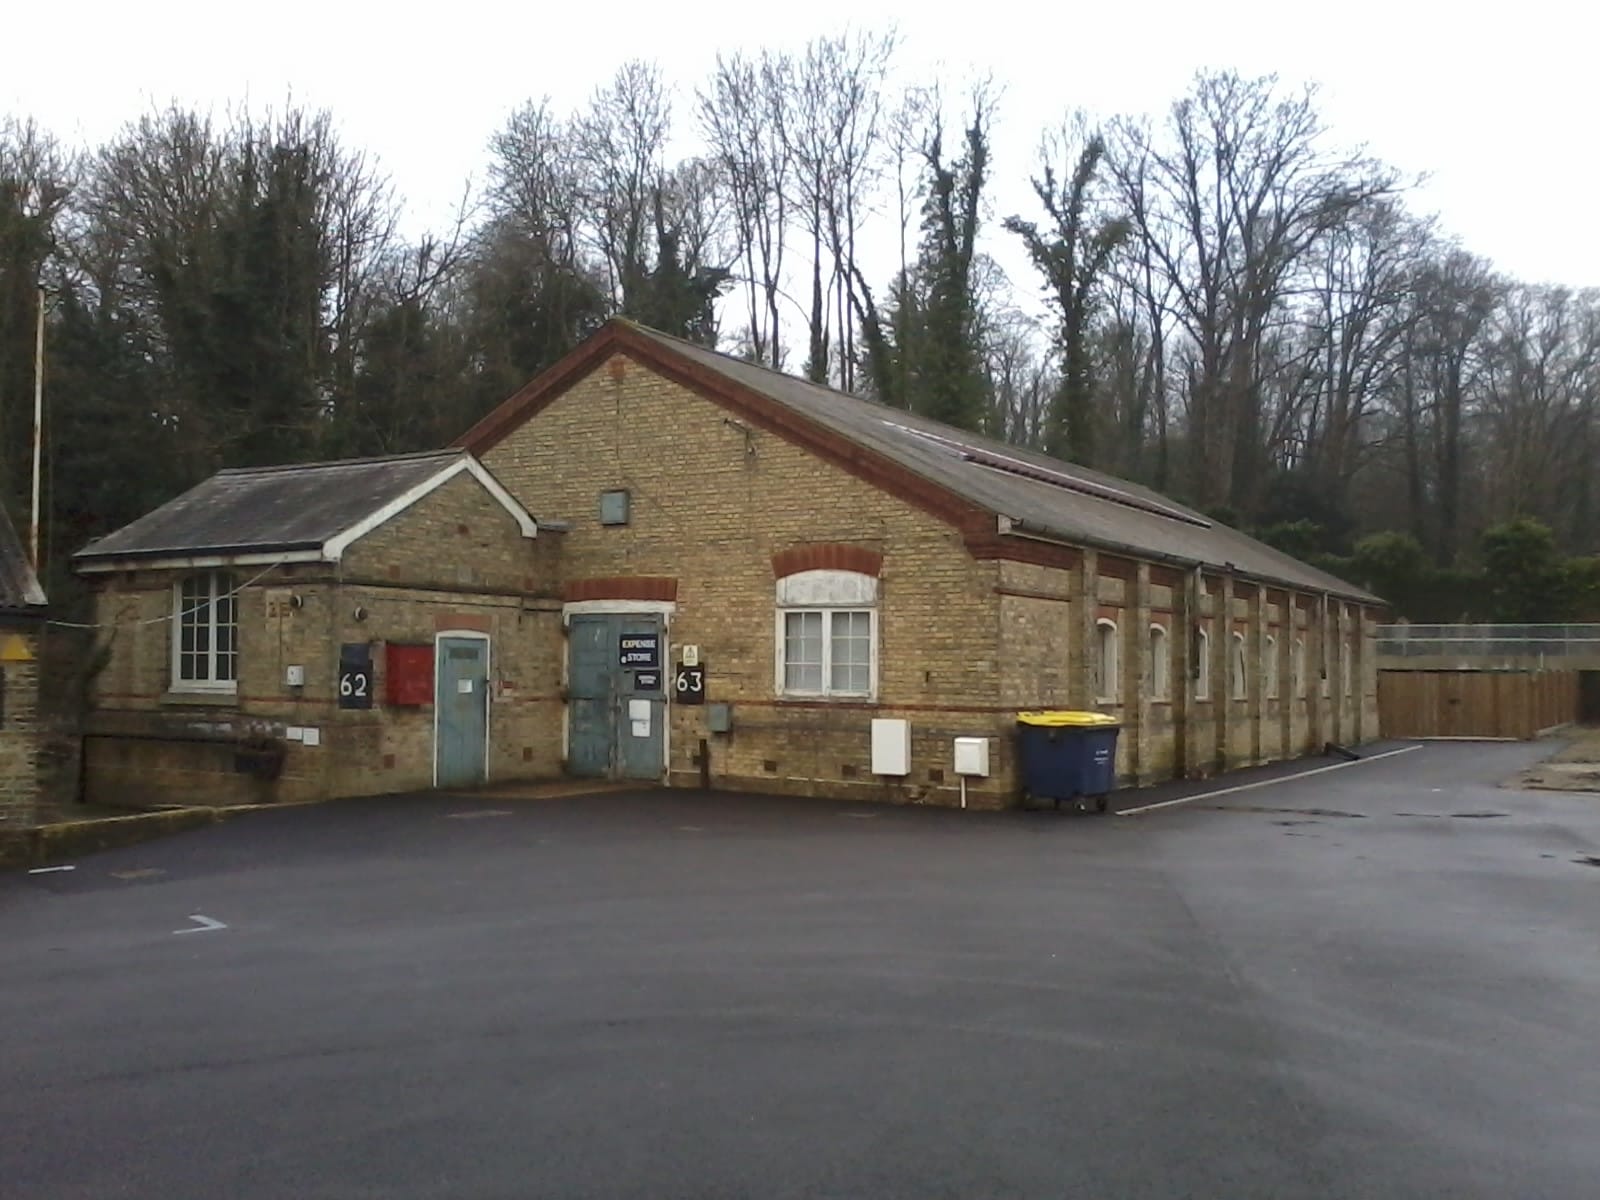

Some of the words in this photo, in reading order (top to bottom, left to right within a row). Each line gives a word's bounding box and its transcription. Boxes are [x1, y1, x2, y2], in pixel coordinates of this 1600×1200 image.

[627, 653, 651, 661] STORE
[341, 673, 366, 696] 62
[677, 672, 702, 692] 63
